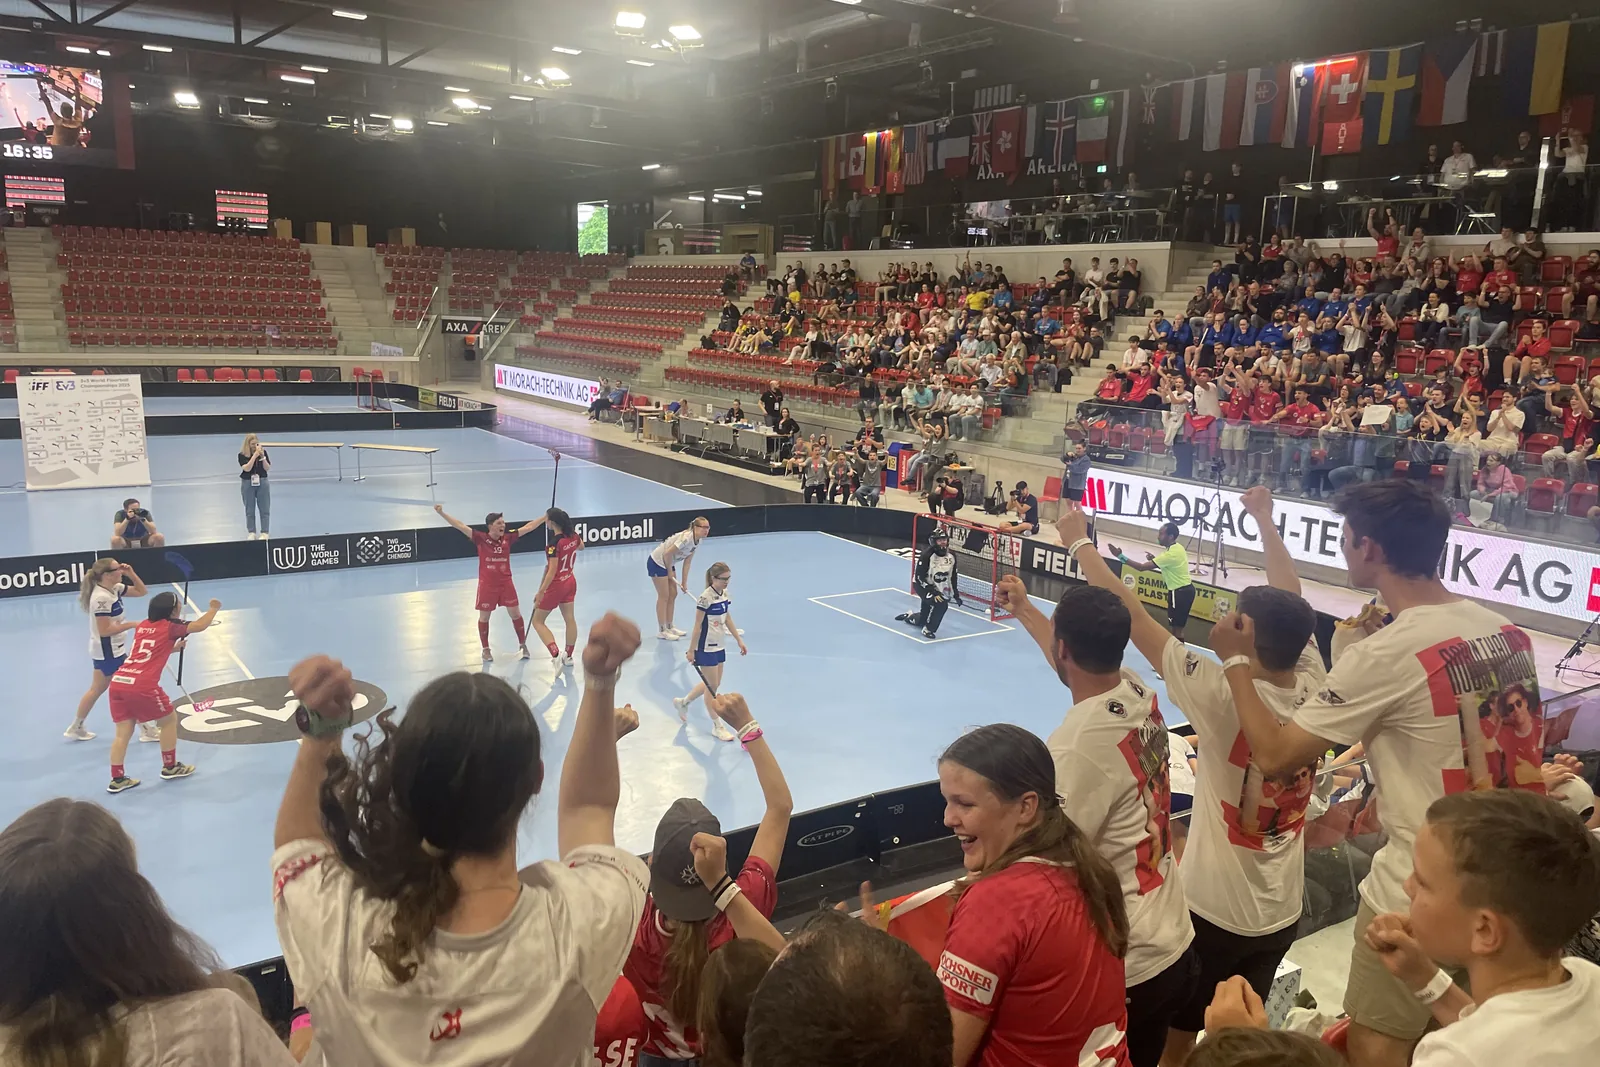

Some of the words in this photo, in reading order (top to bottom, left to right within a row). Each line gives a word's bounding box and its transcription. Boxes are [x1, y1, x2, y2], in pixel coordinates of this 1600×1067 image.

[3, 143, 54, 160] 16:35
[445, 322, 468, 332] AXA
[576, 383, 589, 402] AG
[438, 395, 452, 408] FIELD
[574, 518, 653, 543] floorball
[310, 543, 325, 552] THE
[310, 550, 340, 559] WORLD
[387, 543, 412, 554] 2025
[311, 557, 340, 566] GAMES
[1493, 553, 1574, 604] AG
[803, 834, 825, 844] FAT
[825, 828, 849, 838] PIPE
[941, 954, 993, 990] OCHSNER
[941, 970, 979, 996] SPORT
